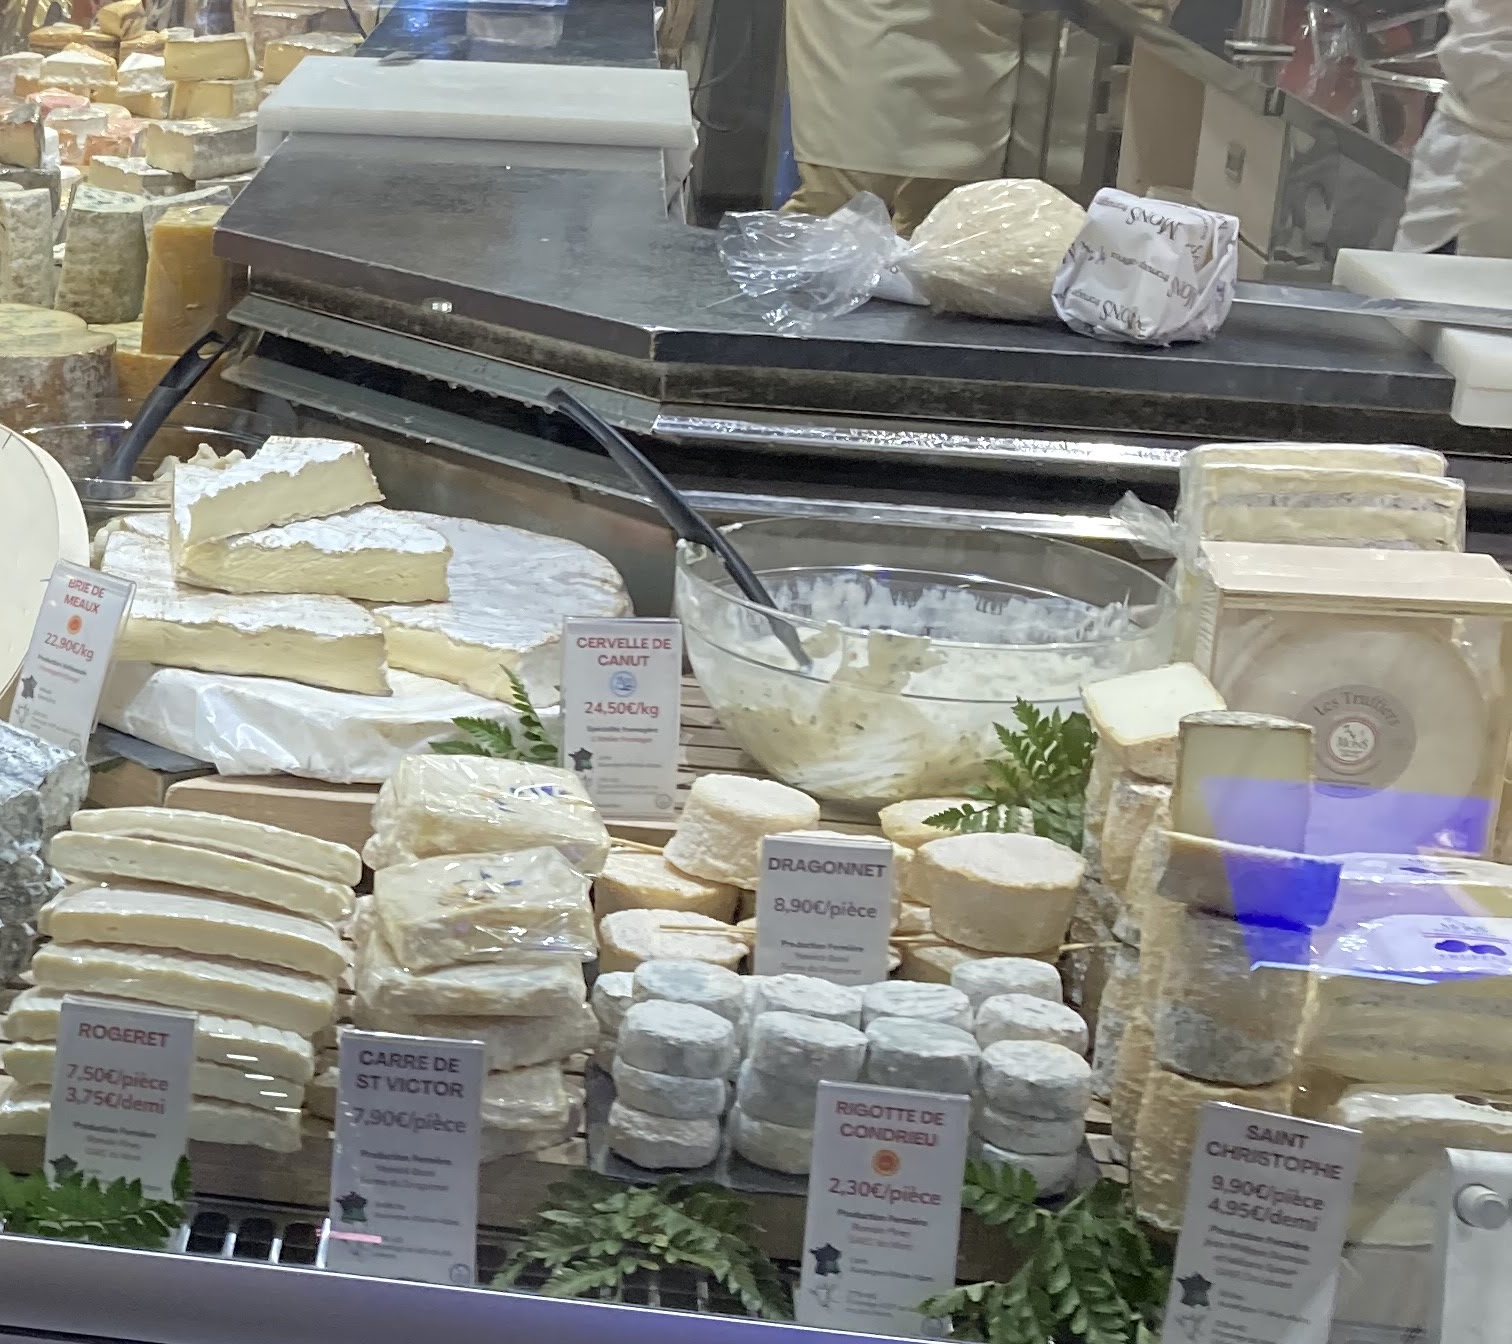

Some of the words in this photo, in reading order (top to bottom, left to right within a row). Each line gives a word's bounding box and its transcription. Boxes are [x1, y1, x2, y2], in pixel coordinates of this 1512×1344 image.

[68, 578, 92, 594] BRIE
[91, 585, 106, 599] DE
[63, 593, 101, 615] MEAUX
[576, 637, 649, 649] CERVELLE
[652, 638, 673, 650] DE
[597, 654, 650, 667] CANUT
[584, 701, 660, 718] 24,50€/kg
[767, 856, 887, 878] DRAGONNET
[773, 897, 877, 920] 8,90€/pièce
[78, 1022, 169, 1048] ROGERET
[434, 1056, 461, 1074] DE
[356, 1073, 381, 1090] ST
[386, 1076, 465, 1099] VICTOR
[835, 1100, 916, 1123] RIGOTTE
[920, 1110, 947, 1126] DE
[840, 1122, 937, 1147] CONDRIEU
[1246, 1124, 1310, 1150] SAINT
[1206, 1140, 1344, 1181] CHRISTOPHE
